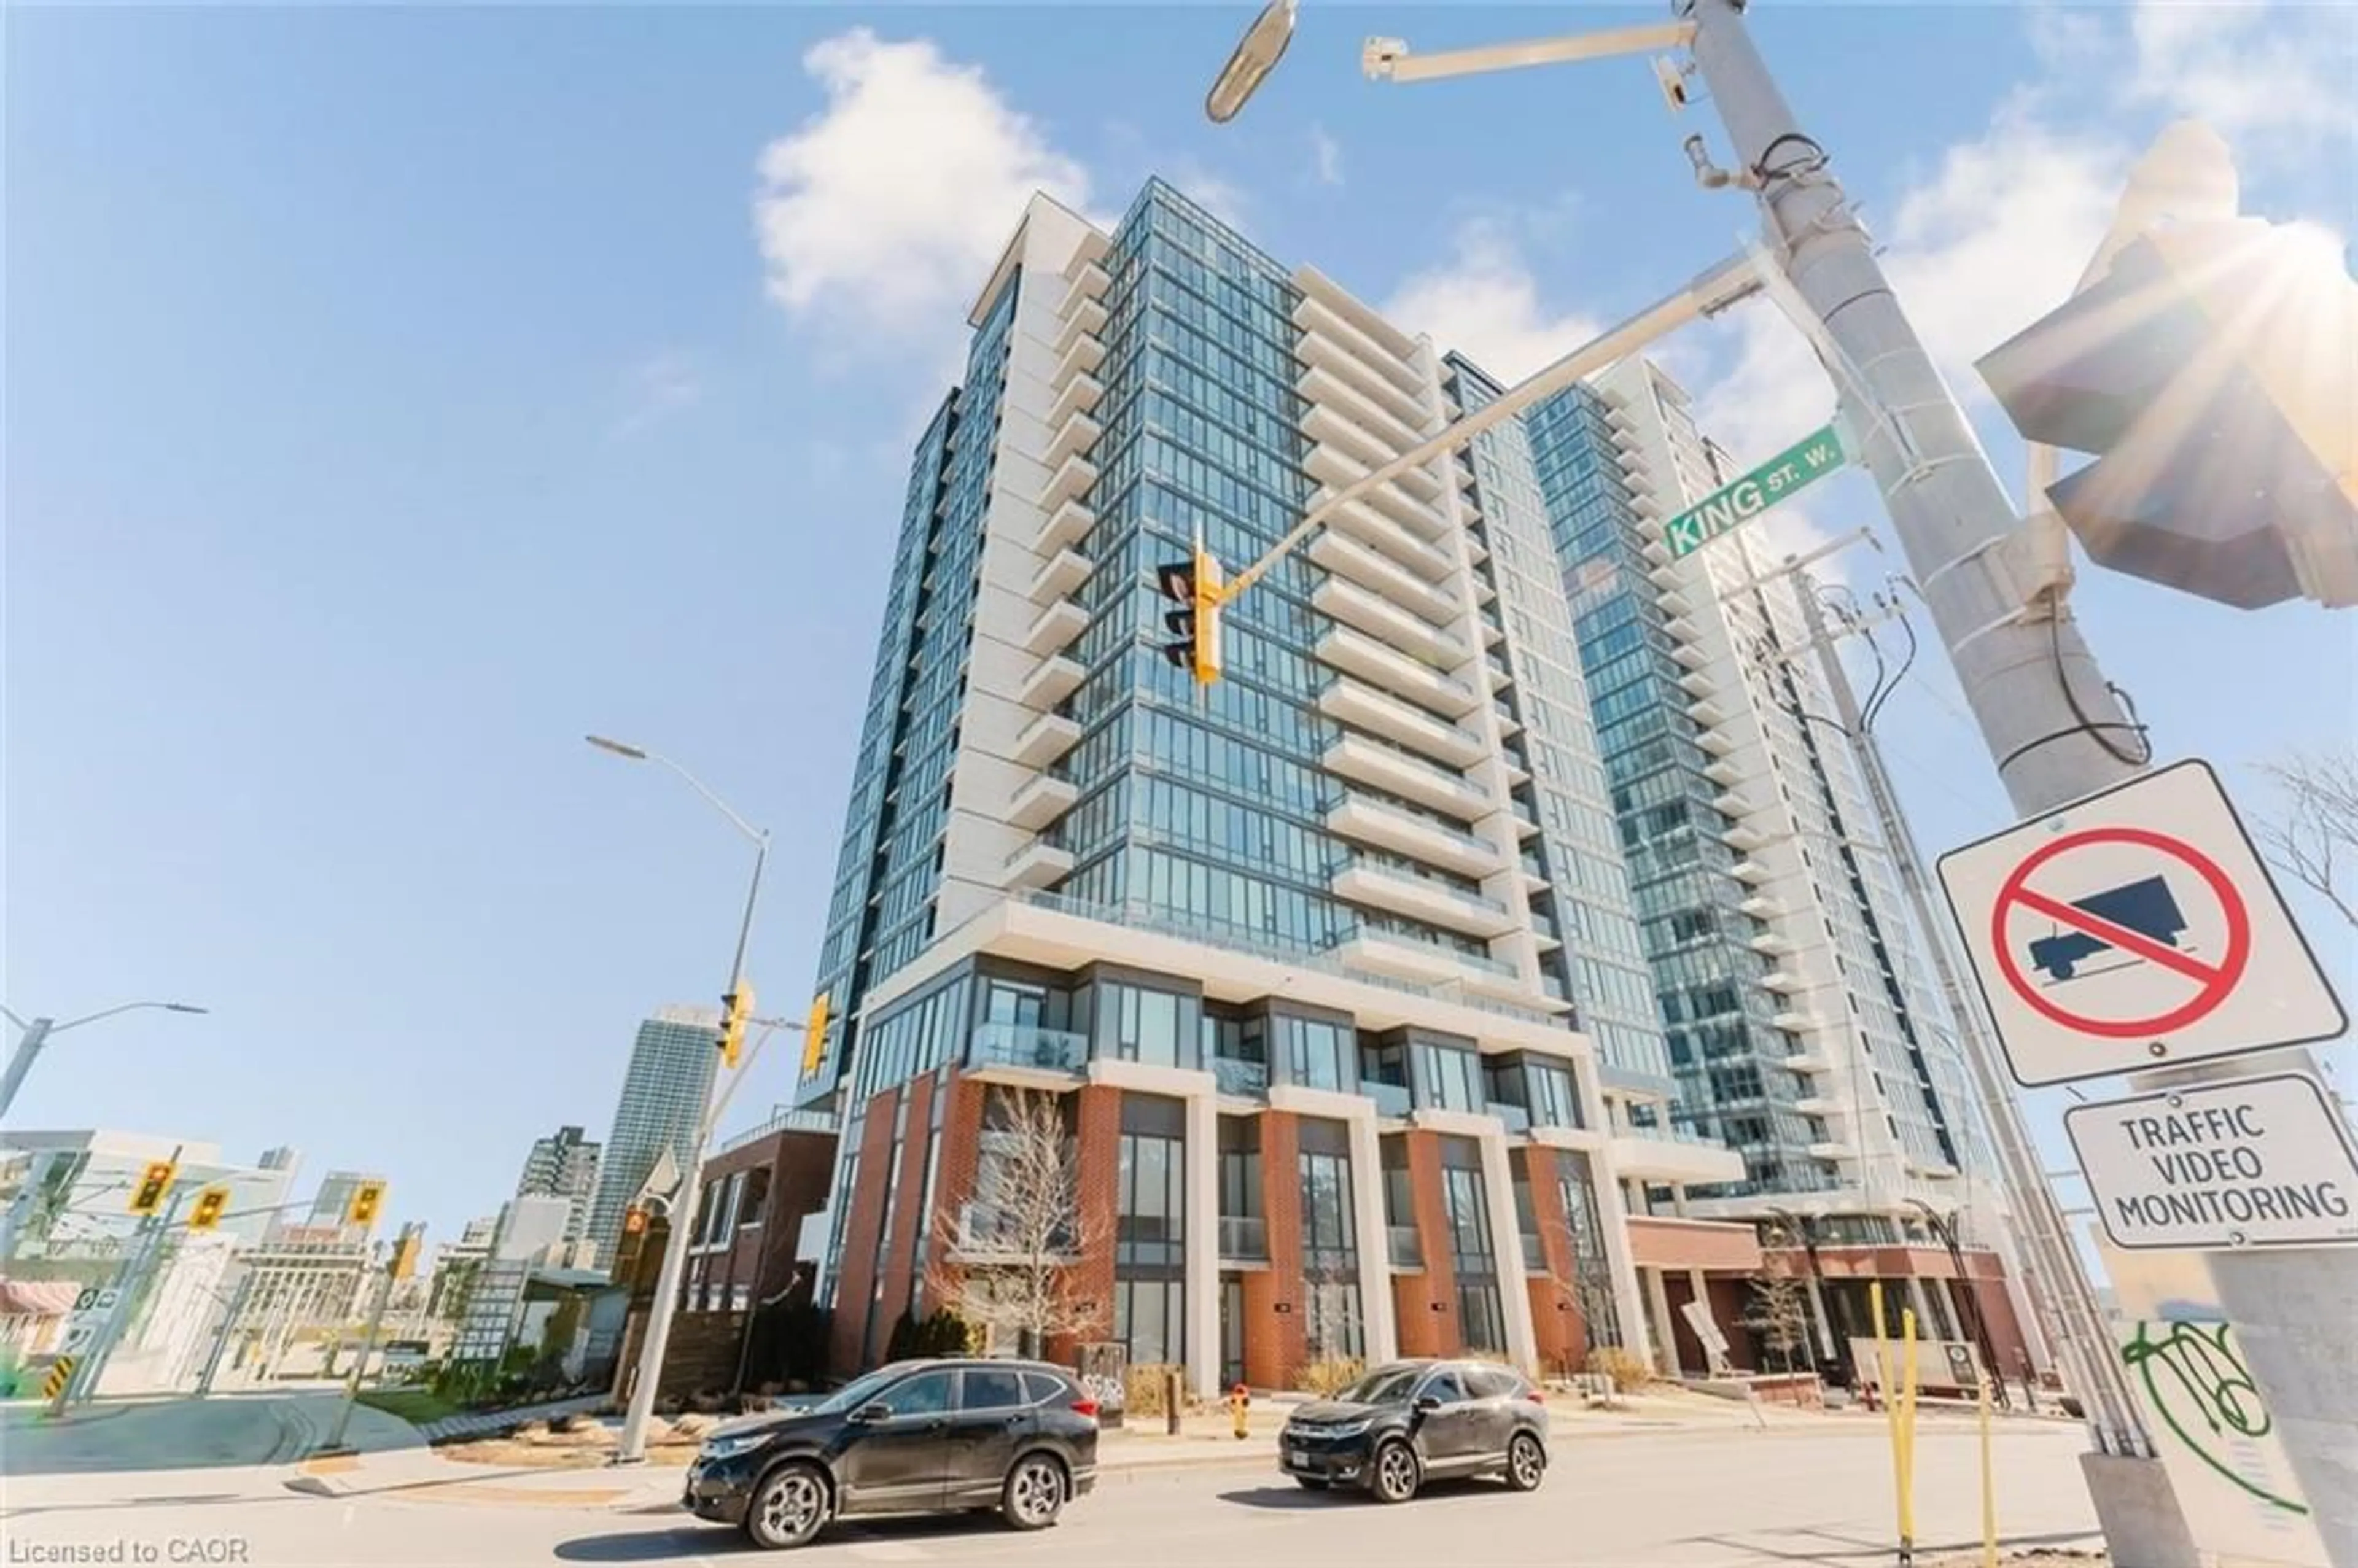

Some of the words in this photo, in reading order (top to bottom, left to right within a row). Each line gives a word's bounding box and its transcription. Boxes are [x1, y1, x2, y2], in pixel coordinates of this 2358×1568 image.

[1669, 481, 1765, 554] KING
[1766, 463, 1800, 492] ST.
[1804, 444, 1837, 468] W.
[2119, 1104, 2265, 1150] TRAFFIC
[2151, 1146, 2263, 1185] VIDEO
[2115, 1182, 2349, 1228] MONITORING
